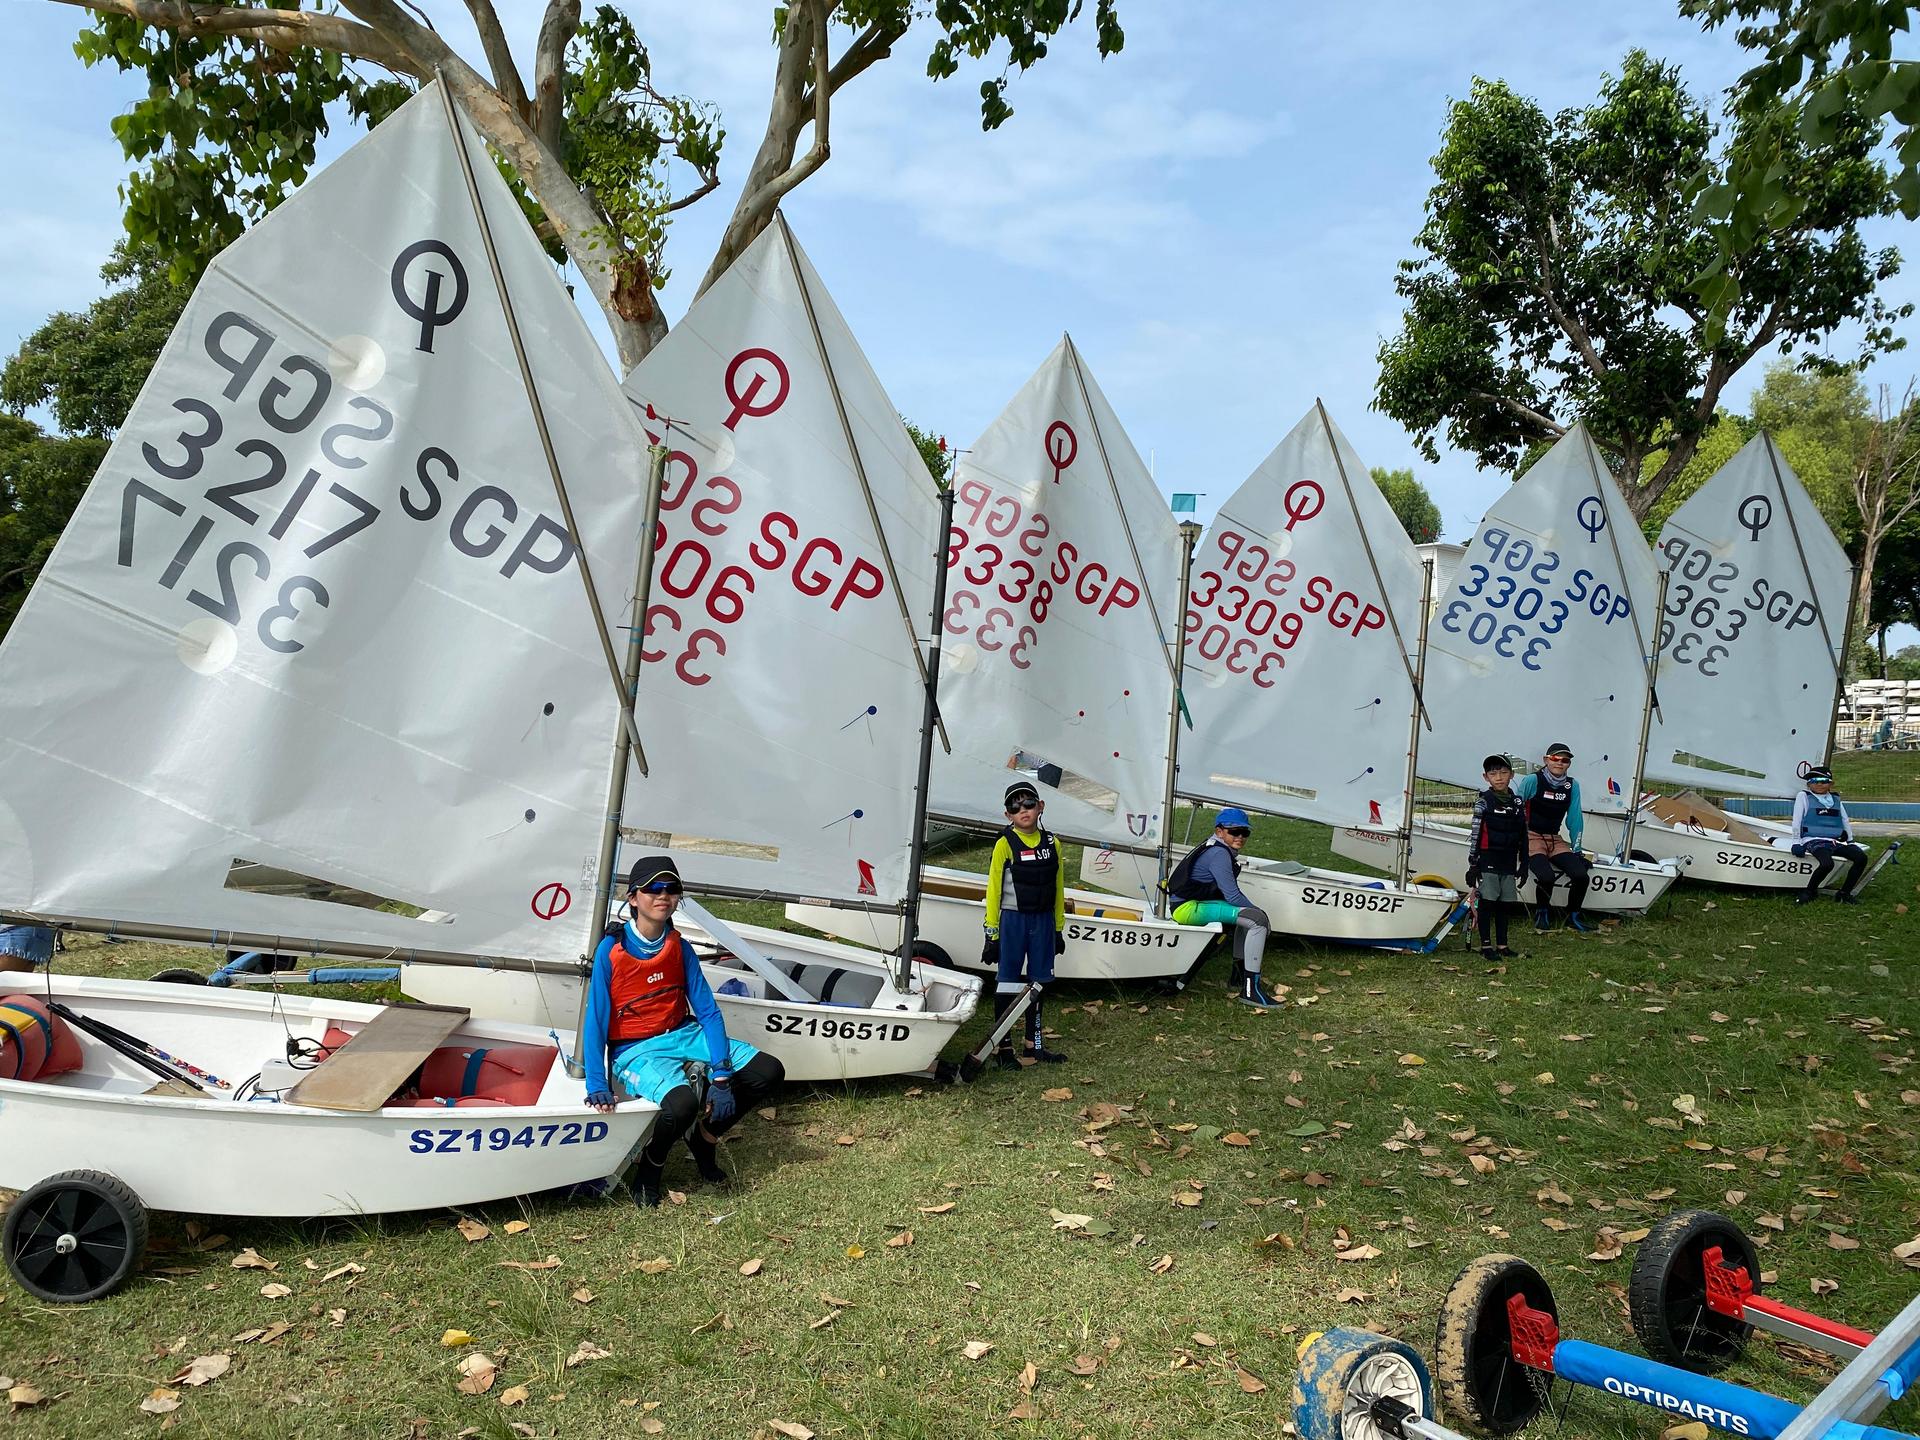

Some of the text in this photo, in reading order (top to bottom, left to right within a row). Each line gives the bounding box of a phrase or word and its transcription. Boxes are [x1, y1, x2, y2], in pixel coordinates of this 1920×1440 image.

[142, 398, 381, 559] 3217
[400, 446, 577, 579] SGP
[749, 512, 884, 611] SGP
[1050, 541, 1140, 617] SGP
[1191, 571, 1303, 650] 3309
[1300, 576, 1385, 638] SGP
[1458, 565, 1569, 634] 3303
[1564, 569, 1630, 626] SGP
[1743, 578, 1817, 631] SGP
[1716, 851, 1813, 875] SZ20228B
[1301, 887, 1405, 913] SZ18952F
[1067, 924, 1180, 948] SZ18891J
[647, 972, 664, 984] Gill
[764, 1013, 910, 1043] SZ19651D
[409, 1120, 609, 1155] SZ19472D
[1603, 1376, 1750, 1436] OPTIPARTS
